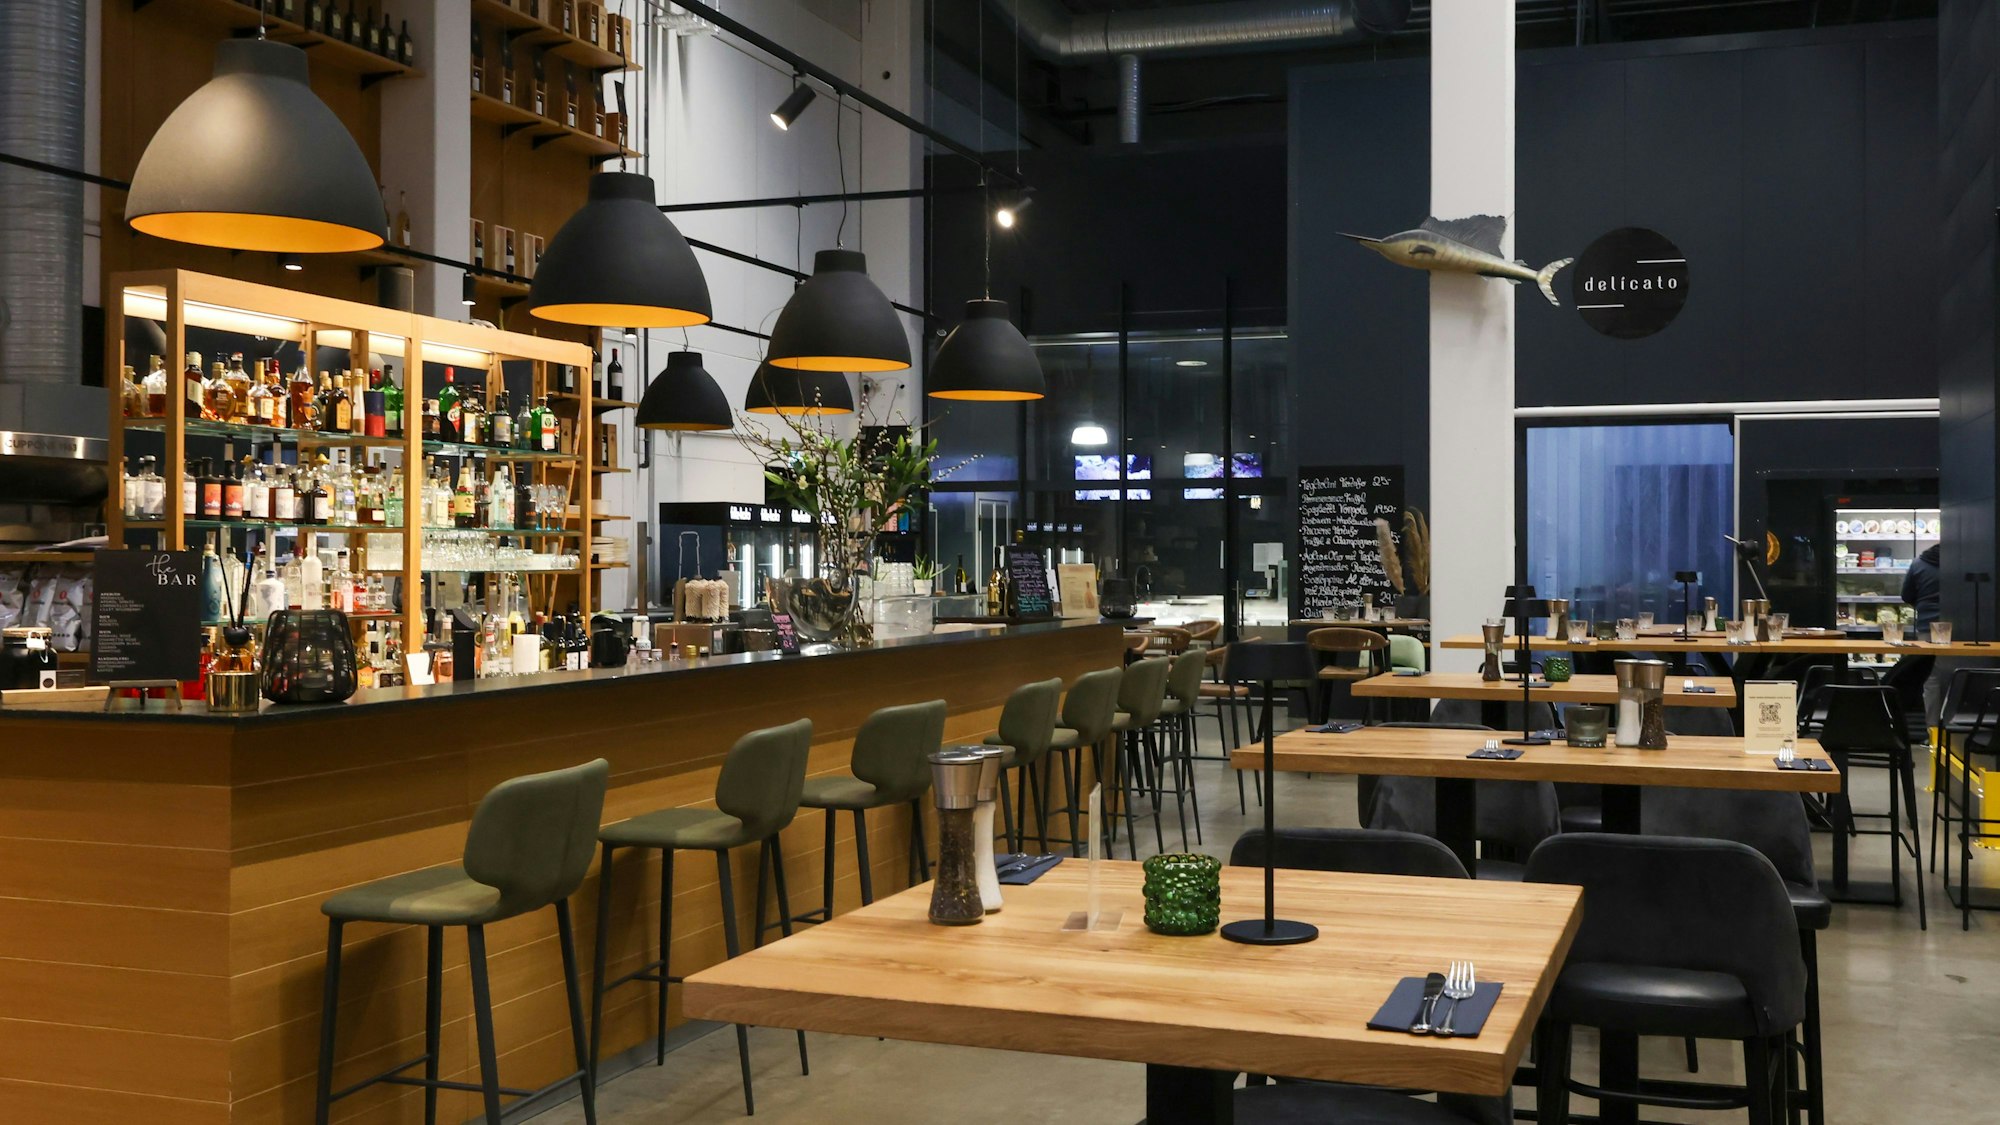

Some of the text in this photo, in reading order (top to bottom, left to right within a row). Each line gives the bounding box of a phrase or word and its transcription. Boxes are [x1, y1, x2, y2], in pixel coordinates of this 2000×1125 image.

[1584, 276, 1678, 292] delicato
[1301, 504, 1336, 516] Spaghetti
[1338, 503, 1368, 518] Vongole
[145, 554, 177, 577] the
[157, 573, 197, 586] BAR
